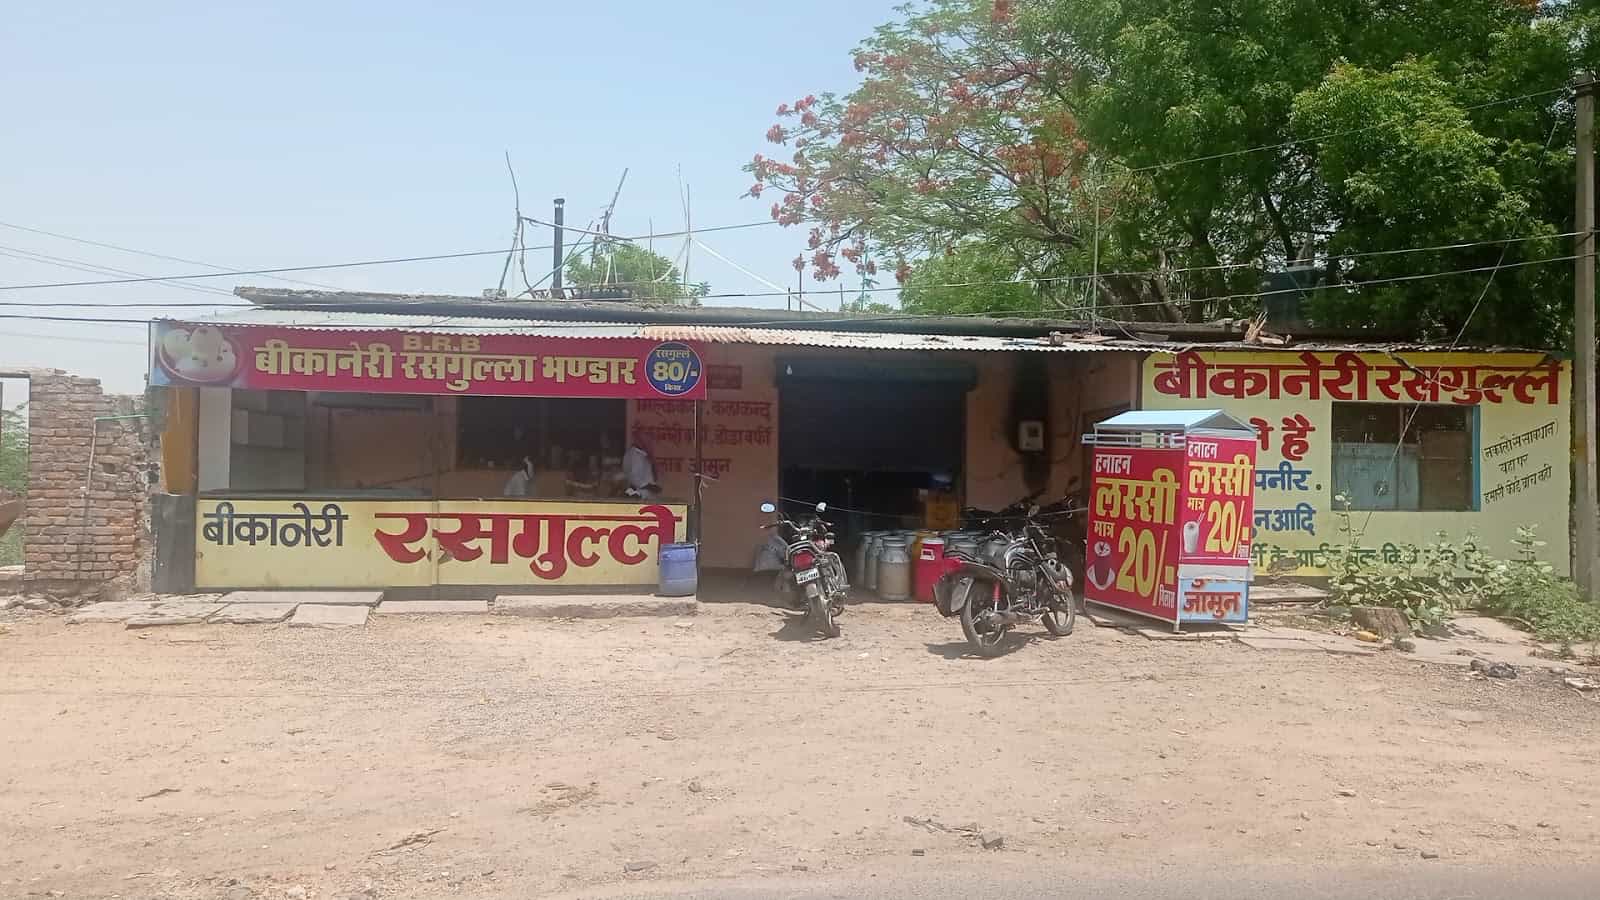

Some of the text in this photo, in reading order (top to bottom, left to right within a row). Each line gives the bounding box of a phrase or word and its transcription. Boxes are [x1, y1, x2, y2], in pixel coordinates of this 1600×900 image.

[254, 339, 640, 391] बीकानेरी रसगुल्ला भण्डार
[403, 336, 480, 351] B.R.B
[653, 361, 698, 384] 80/-
[1153, 351, 1374, 400] बीकानेरी
[1188, 441, 1218, 459] टनाटन
[1281, 414, 1316, 461] है
[1095, 454, 1132, 475] टनाटन
[1188, 454, 1254, 497] लस्सी
[1255, 460, 1312, 490] पनीर
[1095, 468, 1180, 525] लस्सी
[202, 503, 683, 581] बीकानेरी रसगुल्ले
[1187, 497, 1205, 512] मात्र
[1205, 500, 1250, 559] 20/-
[1093, 520, 1175, 606] मात्र 20/-
[1183, 591, 1241, 618] जामुन
